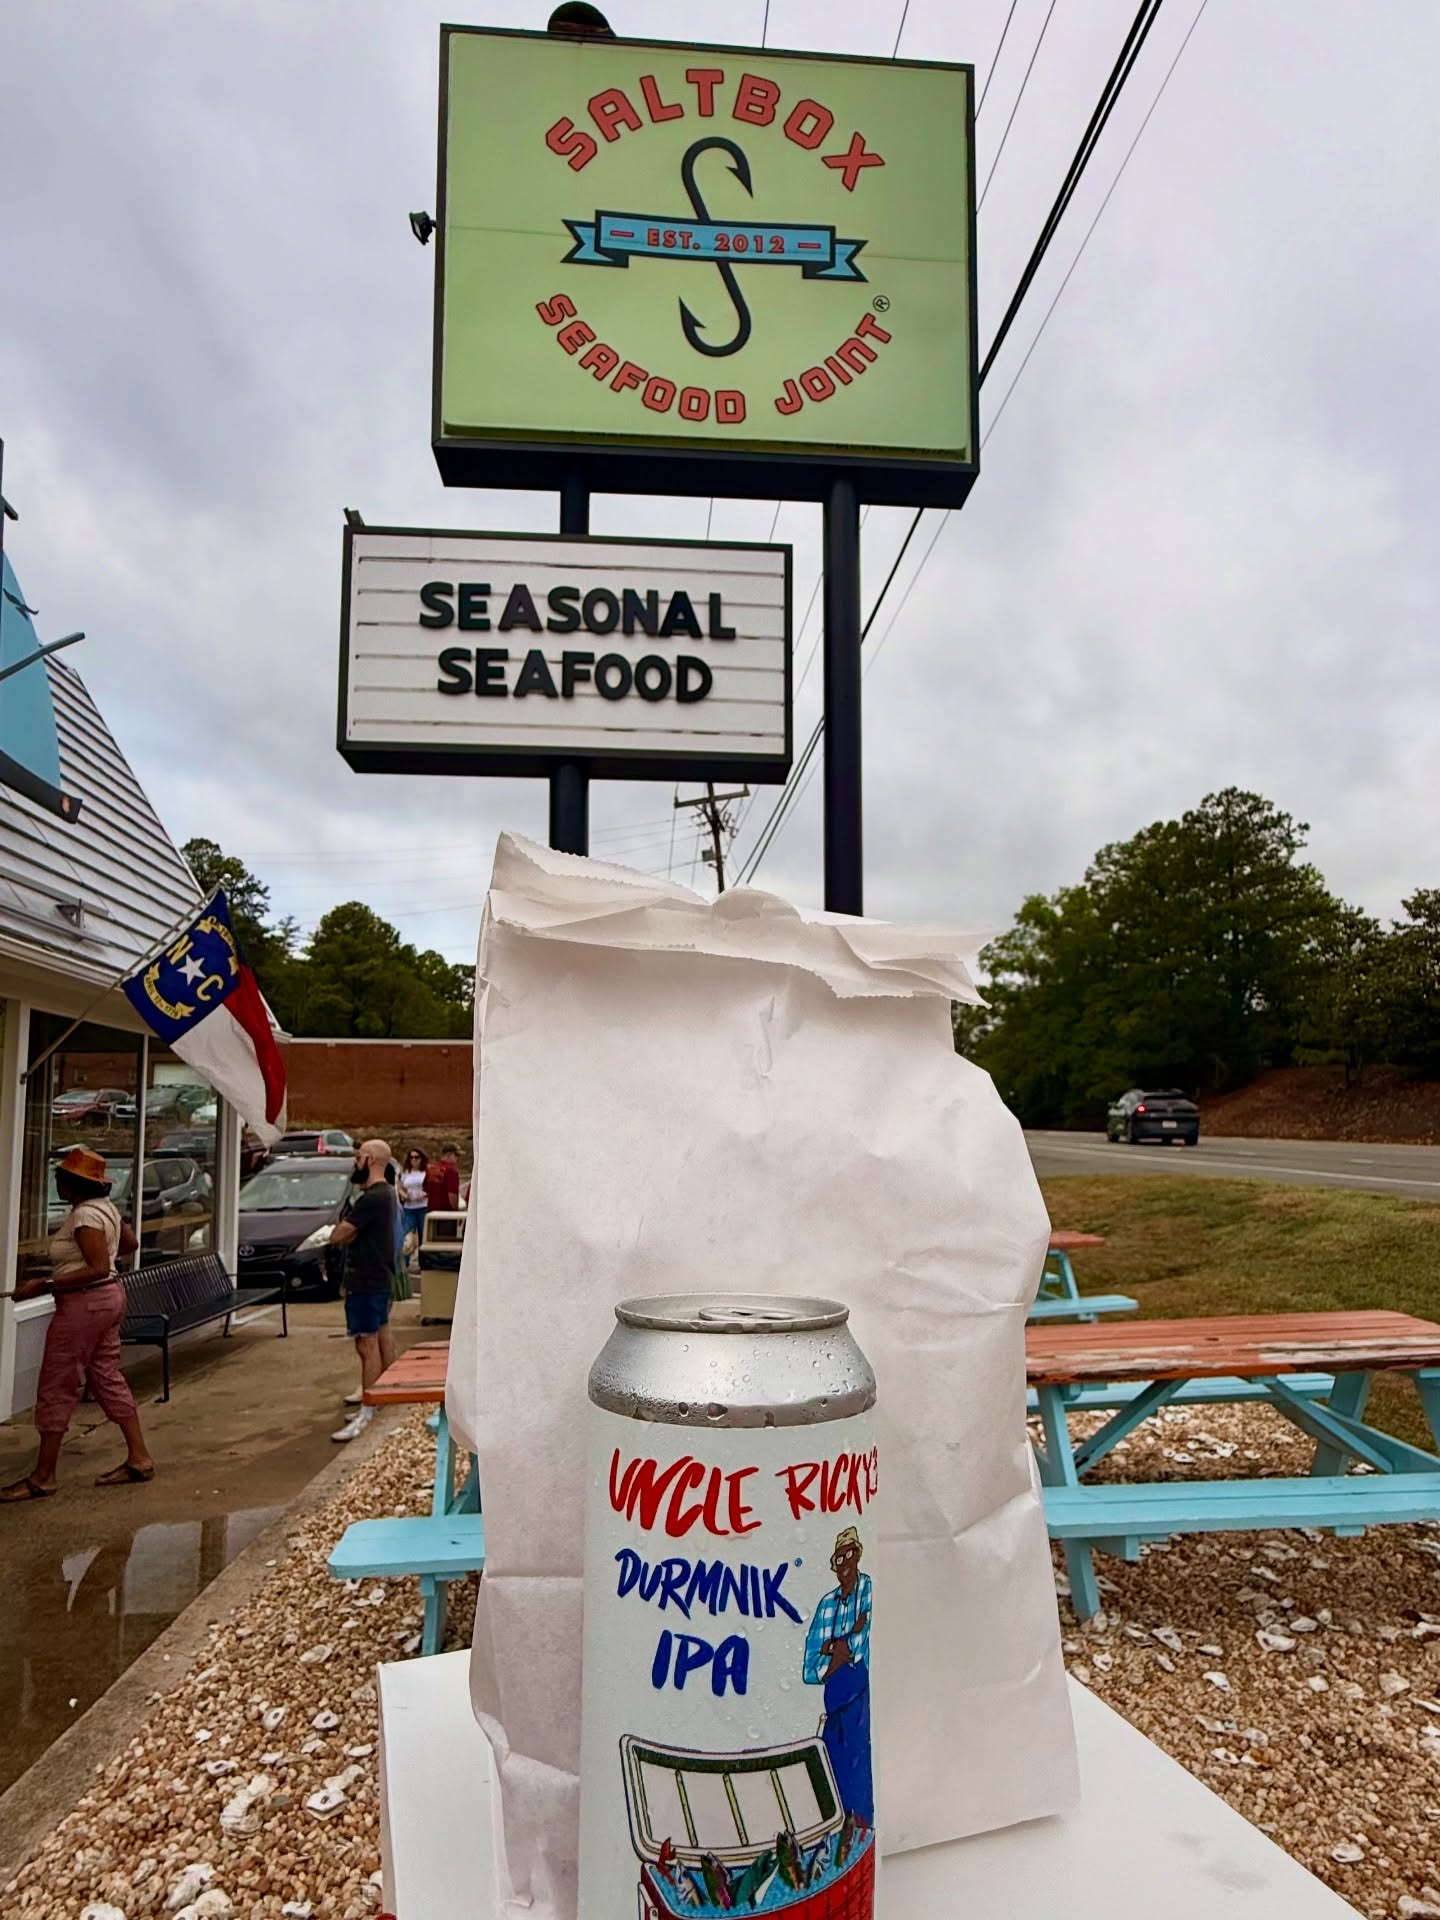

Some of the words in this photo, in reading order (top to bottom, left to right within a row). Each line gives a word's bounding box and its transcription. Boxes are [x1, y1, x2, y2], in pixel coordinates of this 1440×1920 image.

[545, 68, 886, 192] SALTBOX
[647, 227, 701, 250] EST.
[714, 232, 786, 255] 2012
[535, 293, 747, 424] SEAFOOD
[418, 580, 737, 640] SEASONAL
[436, 646, 714, 704] SEAFOOD
[165, 933, 195, 966] N
[196, 973, 224, 1002] C
[608, 1447, 763, 1538] UNCLE
[651, 1628, 750, 1697] IPA
